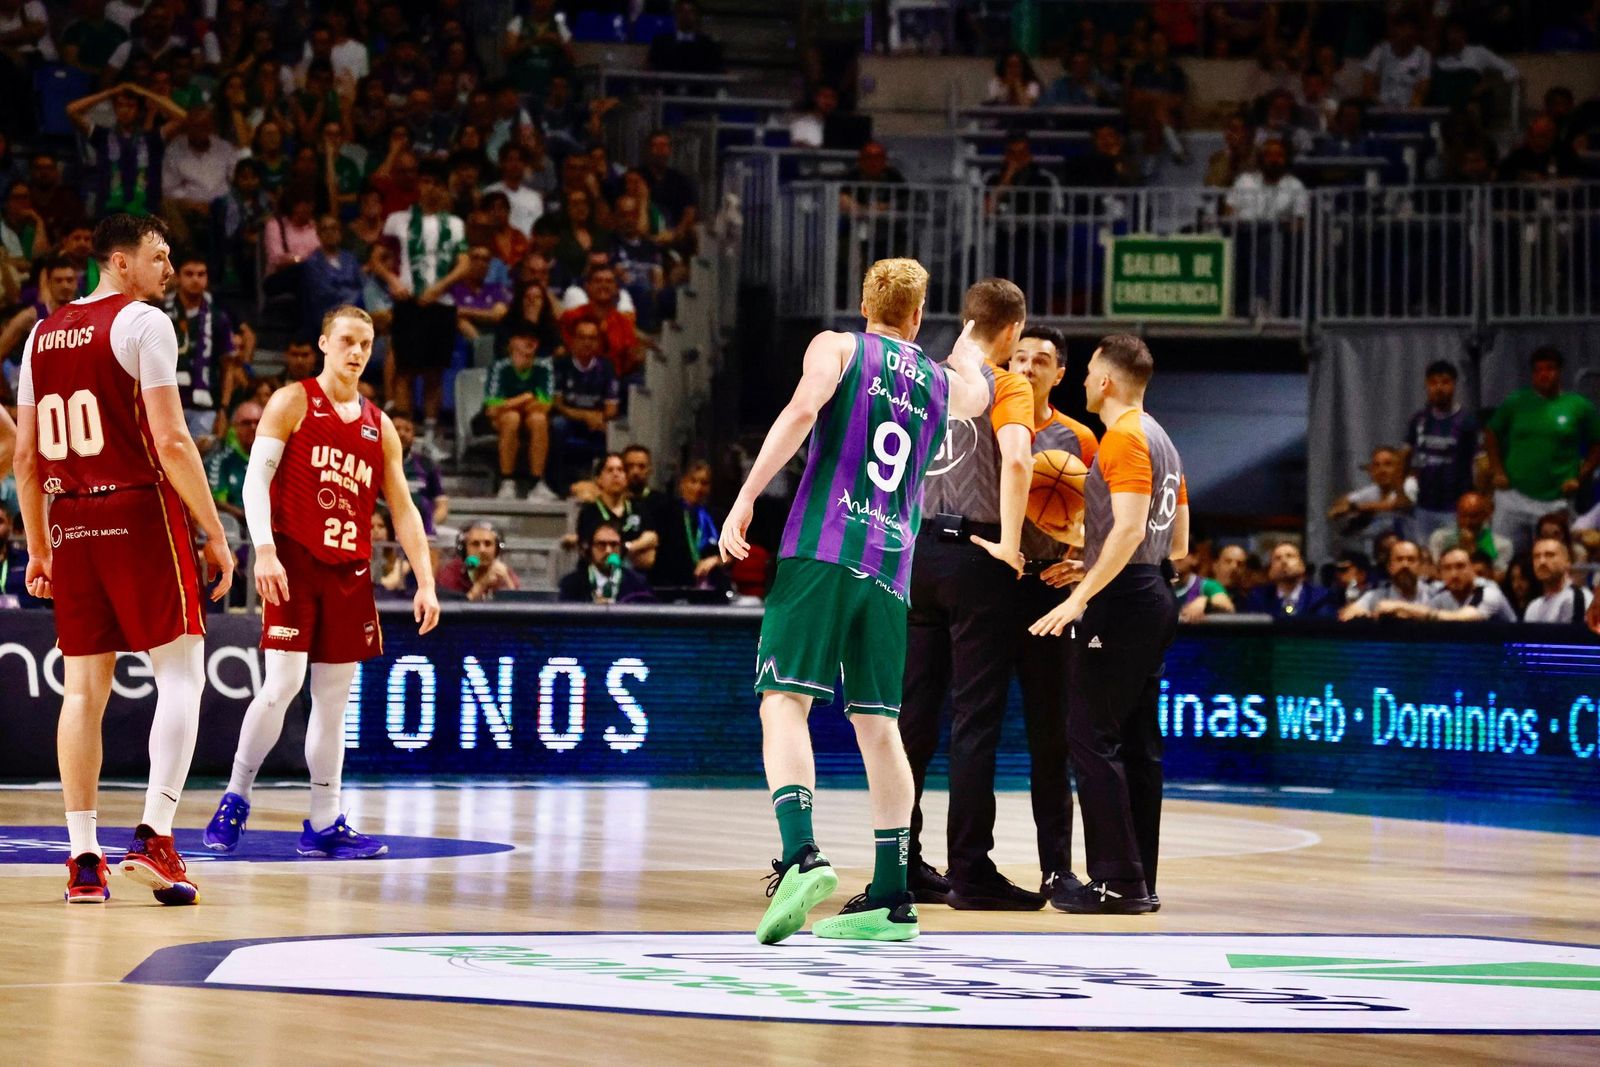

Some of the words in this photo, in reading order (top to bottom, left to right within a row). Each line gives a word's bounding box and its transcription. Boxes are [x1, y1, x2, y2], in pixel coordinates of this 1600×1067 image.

[1115, 281, 1219, 305] EMERGENCIA
[37, 325, 95, 354] KURUCS
[886, 350, 926, 387] Díaz
[36, 388, 105, 462] 00
[310, 445, 373, 489] UCAM
[866, 421, 912, 493] 9
[320, 470, 360, 497] MURCIA
[100, 528, 129, 537] MURCIA
[323, 517, 358, 552] 22
[1276, 683, 1346, 743] web
[1372, 687, 1539, 755] Dominios
[376, 945, 961, 1013] Baloncesto
[642, 952, 1093, 1000] Unicaja
